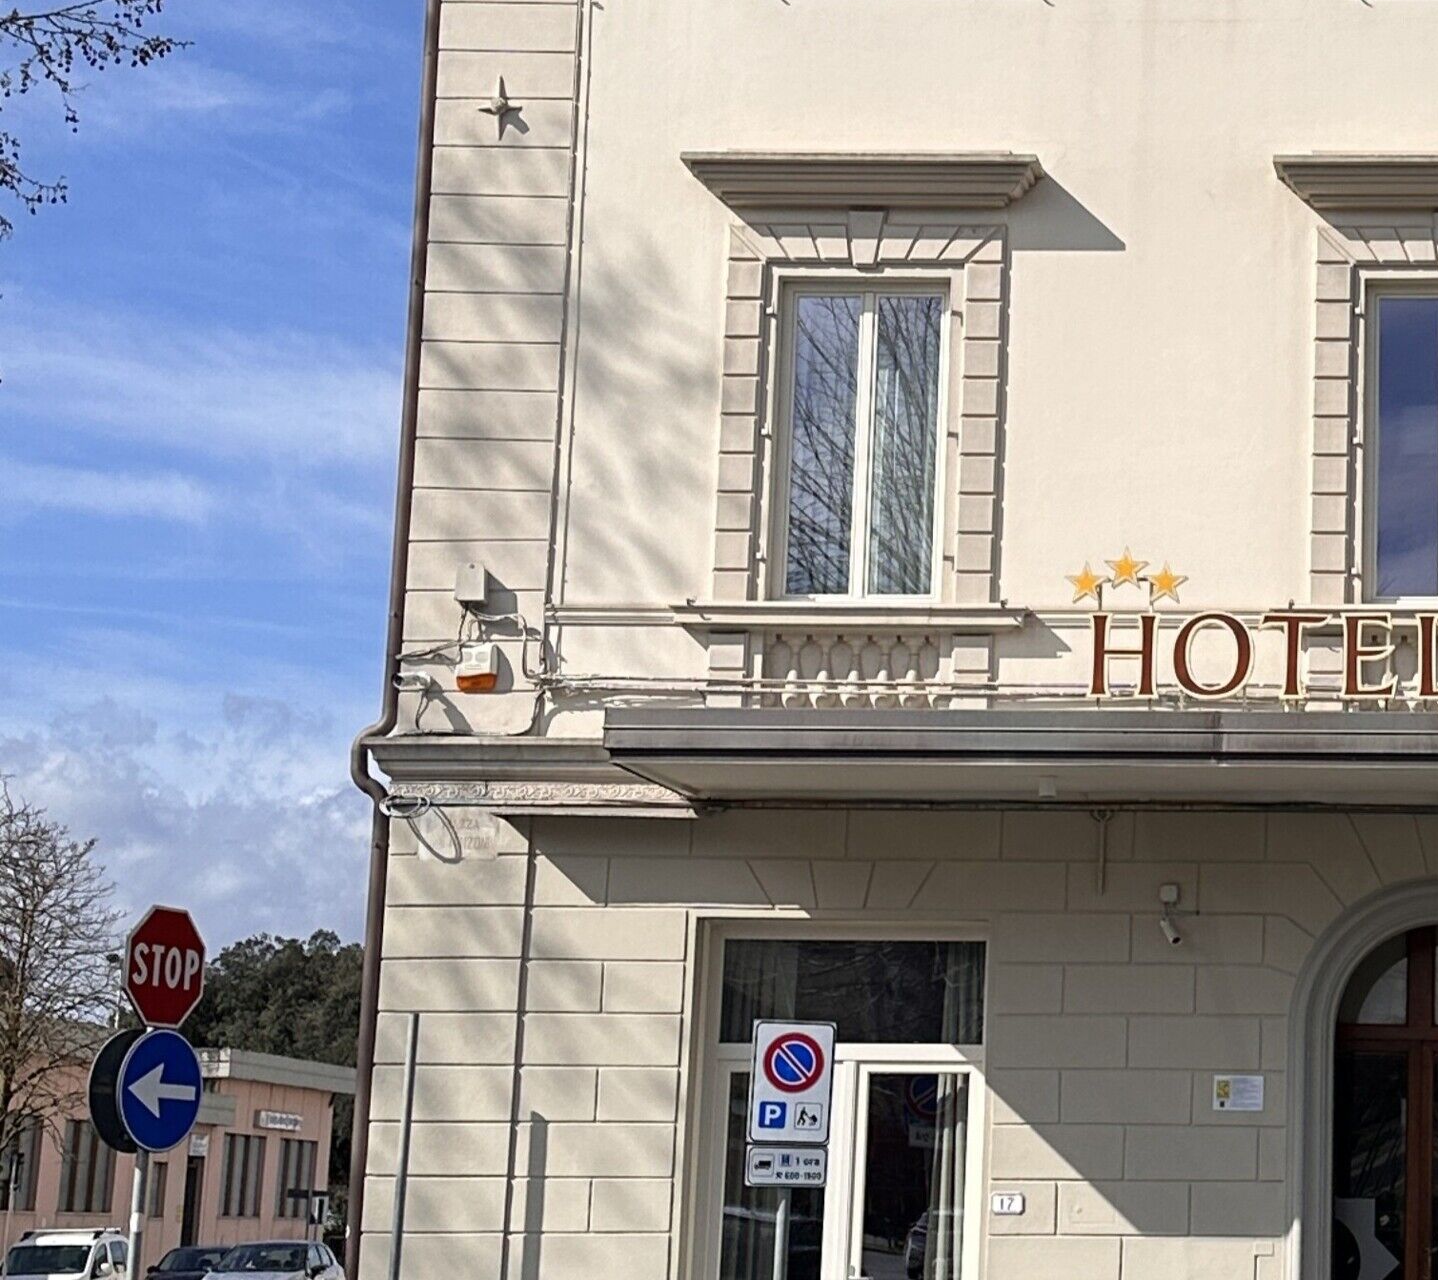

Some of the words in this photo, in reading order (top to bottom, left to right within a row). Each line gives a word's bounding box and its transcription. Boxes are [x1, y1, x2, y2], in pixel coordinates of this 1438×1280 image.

[132, 942, 200, 991] STOP
[764, 1104, 782, 1126] P
[1000, 1197, 1015, 1211] 17
